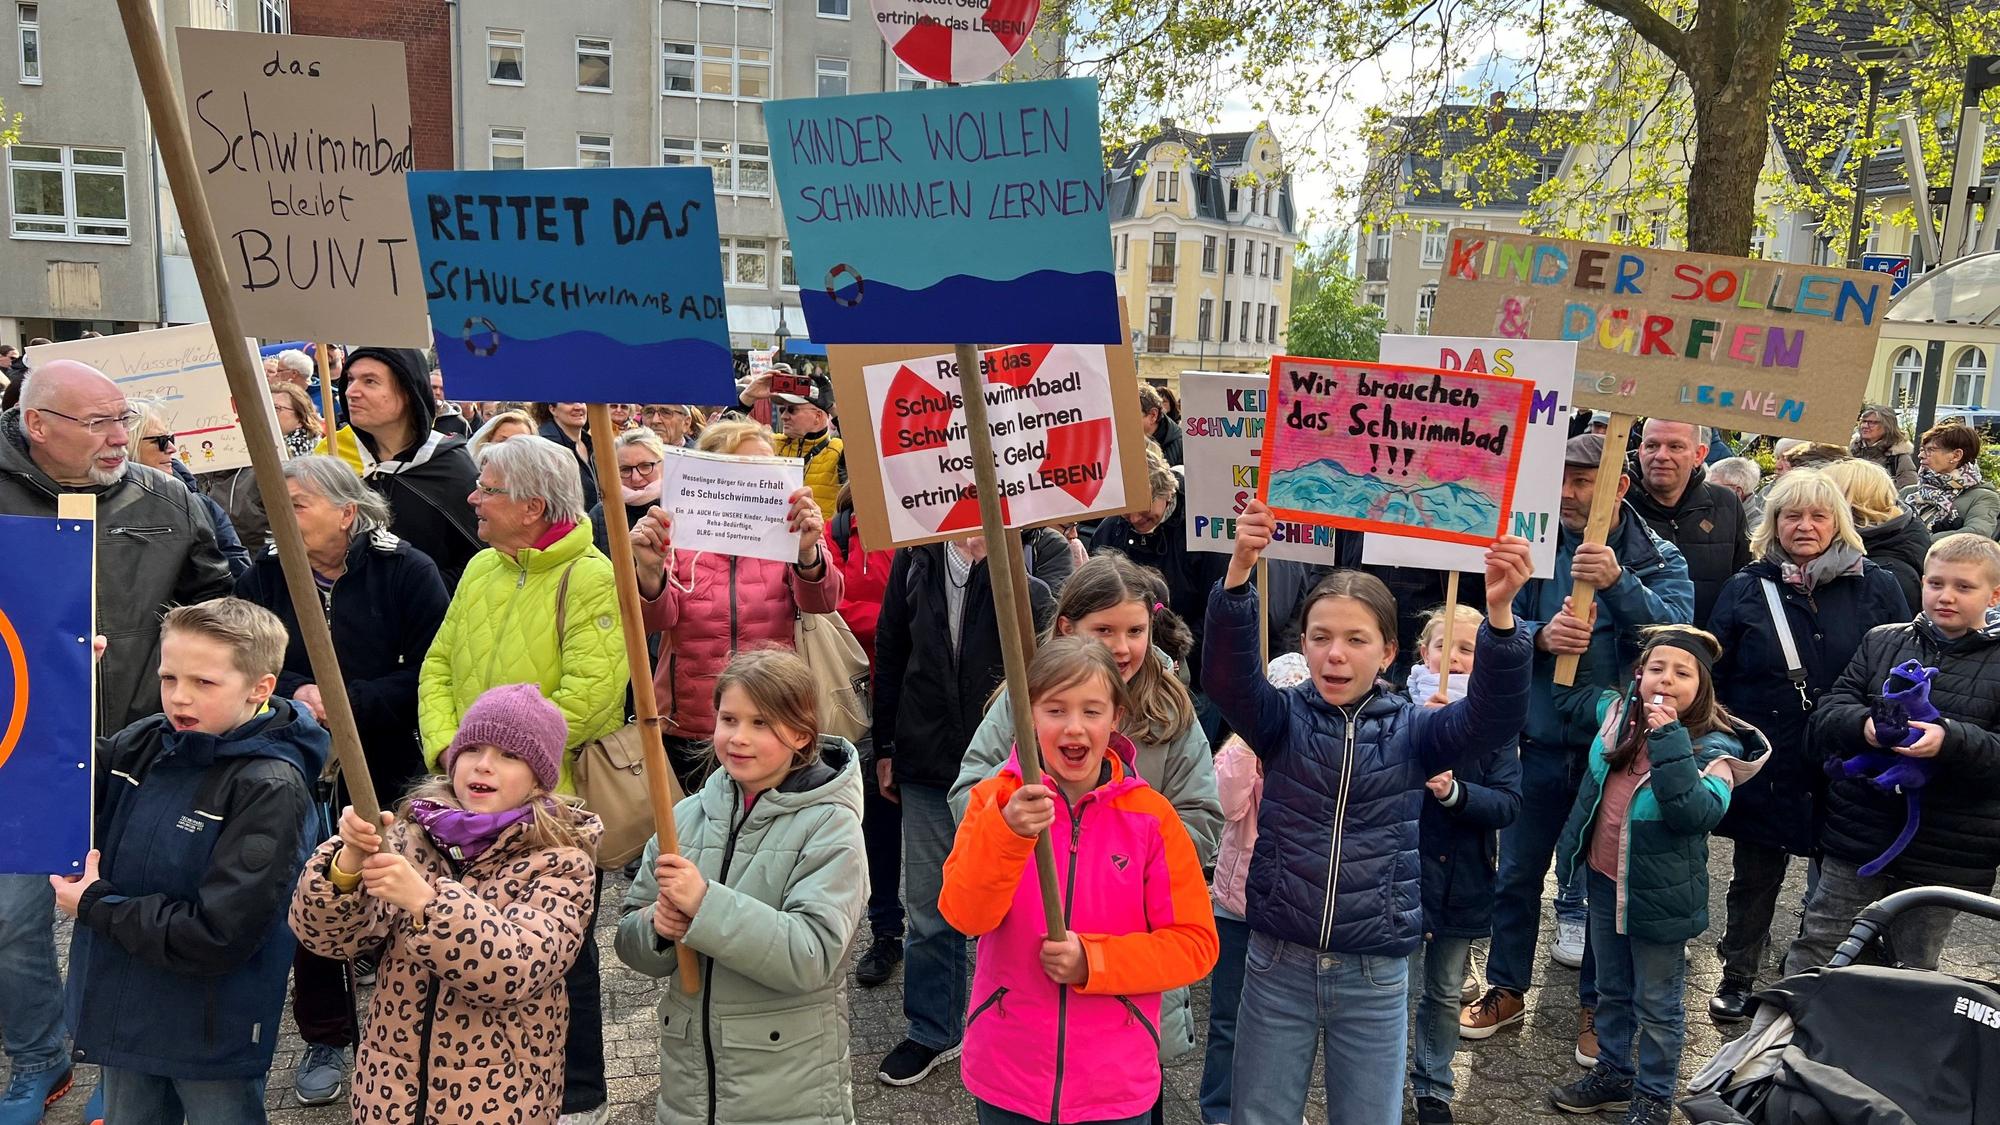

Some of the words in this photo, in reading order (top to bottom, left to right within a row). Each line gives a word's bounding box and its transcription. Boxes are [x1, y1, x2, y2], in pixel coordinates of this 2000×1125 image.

[877, 10, 941, 28] ertrinken
[945, 15, 969, 32] das
[972, 17, 1026, 36] LEBEN!
[263, 50, 321, 77] das
[196, 89, 416, 176] Schwimmbad
[788, 113, 902, 167] KINDER
[922, 106, 1069, 163] WOLLEN
[268, 180, 354, 221] bleibt
[796, 180, 971, 223] SCHWIMMEN
[989, 175, 1106, 220] LERNEN
[427, 194, 589, 246] RETTET
[613, 197, 700, 246] DAS
[231, 229, 408, 296] BUNT
[426, 260, 725, 321] SCHULSCHWIMMBAD!
[1448, 239, 1646, 294] KINDER
[1671, 263, 1880, 326] SOLLEN
[1500, 298, 1529, 339] &
[936, 353, 998, 380] Reet
[1001, 351, 1032, 372] das
[1440, 347, 1515, 378] DAS
[895, 371, 1083, 417] Schulswimmbad!
[1226, 388, 1267, 412] KEI
[1289, 370, 1338, 397] Wir
[1358, 373, 1480, 408] brauchen
[1017, 407, 1083, 432] lernen
[1186, 417, 1266, 438] SCHWIM
[1287, 400, 1330, 431] das
[1348, 402, 1509, 456] Schwimmbad
[938, 450, 1000, 474] kost
[1003, 440, 1052, 466] Geld,
[1369, 443, 1415, 477] !!!
[680, 487, 695, 498] des
[697, 488, 783, 506] Schulschwimmbades
[682, 473, 716, 485] Wesselinger
[737, 480, 746, 488] für
[746, 480, 757, 488] den
[759, 479, 784, 490] Erhalt
[901, 484, 979, 510] ertrinke
[998, 478, 1025, 498] das
[1028, 460, 1104, 492] LEBEN!
[721, 511, 742, 519] UNSERE
[743, 512, 763, 522] Kinder,
[1195, 515, 1335, 548] PFECHEN!
[726, 532, 762, 542] Sportvereine
[1953, 996, 1970, 1015] TUS
